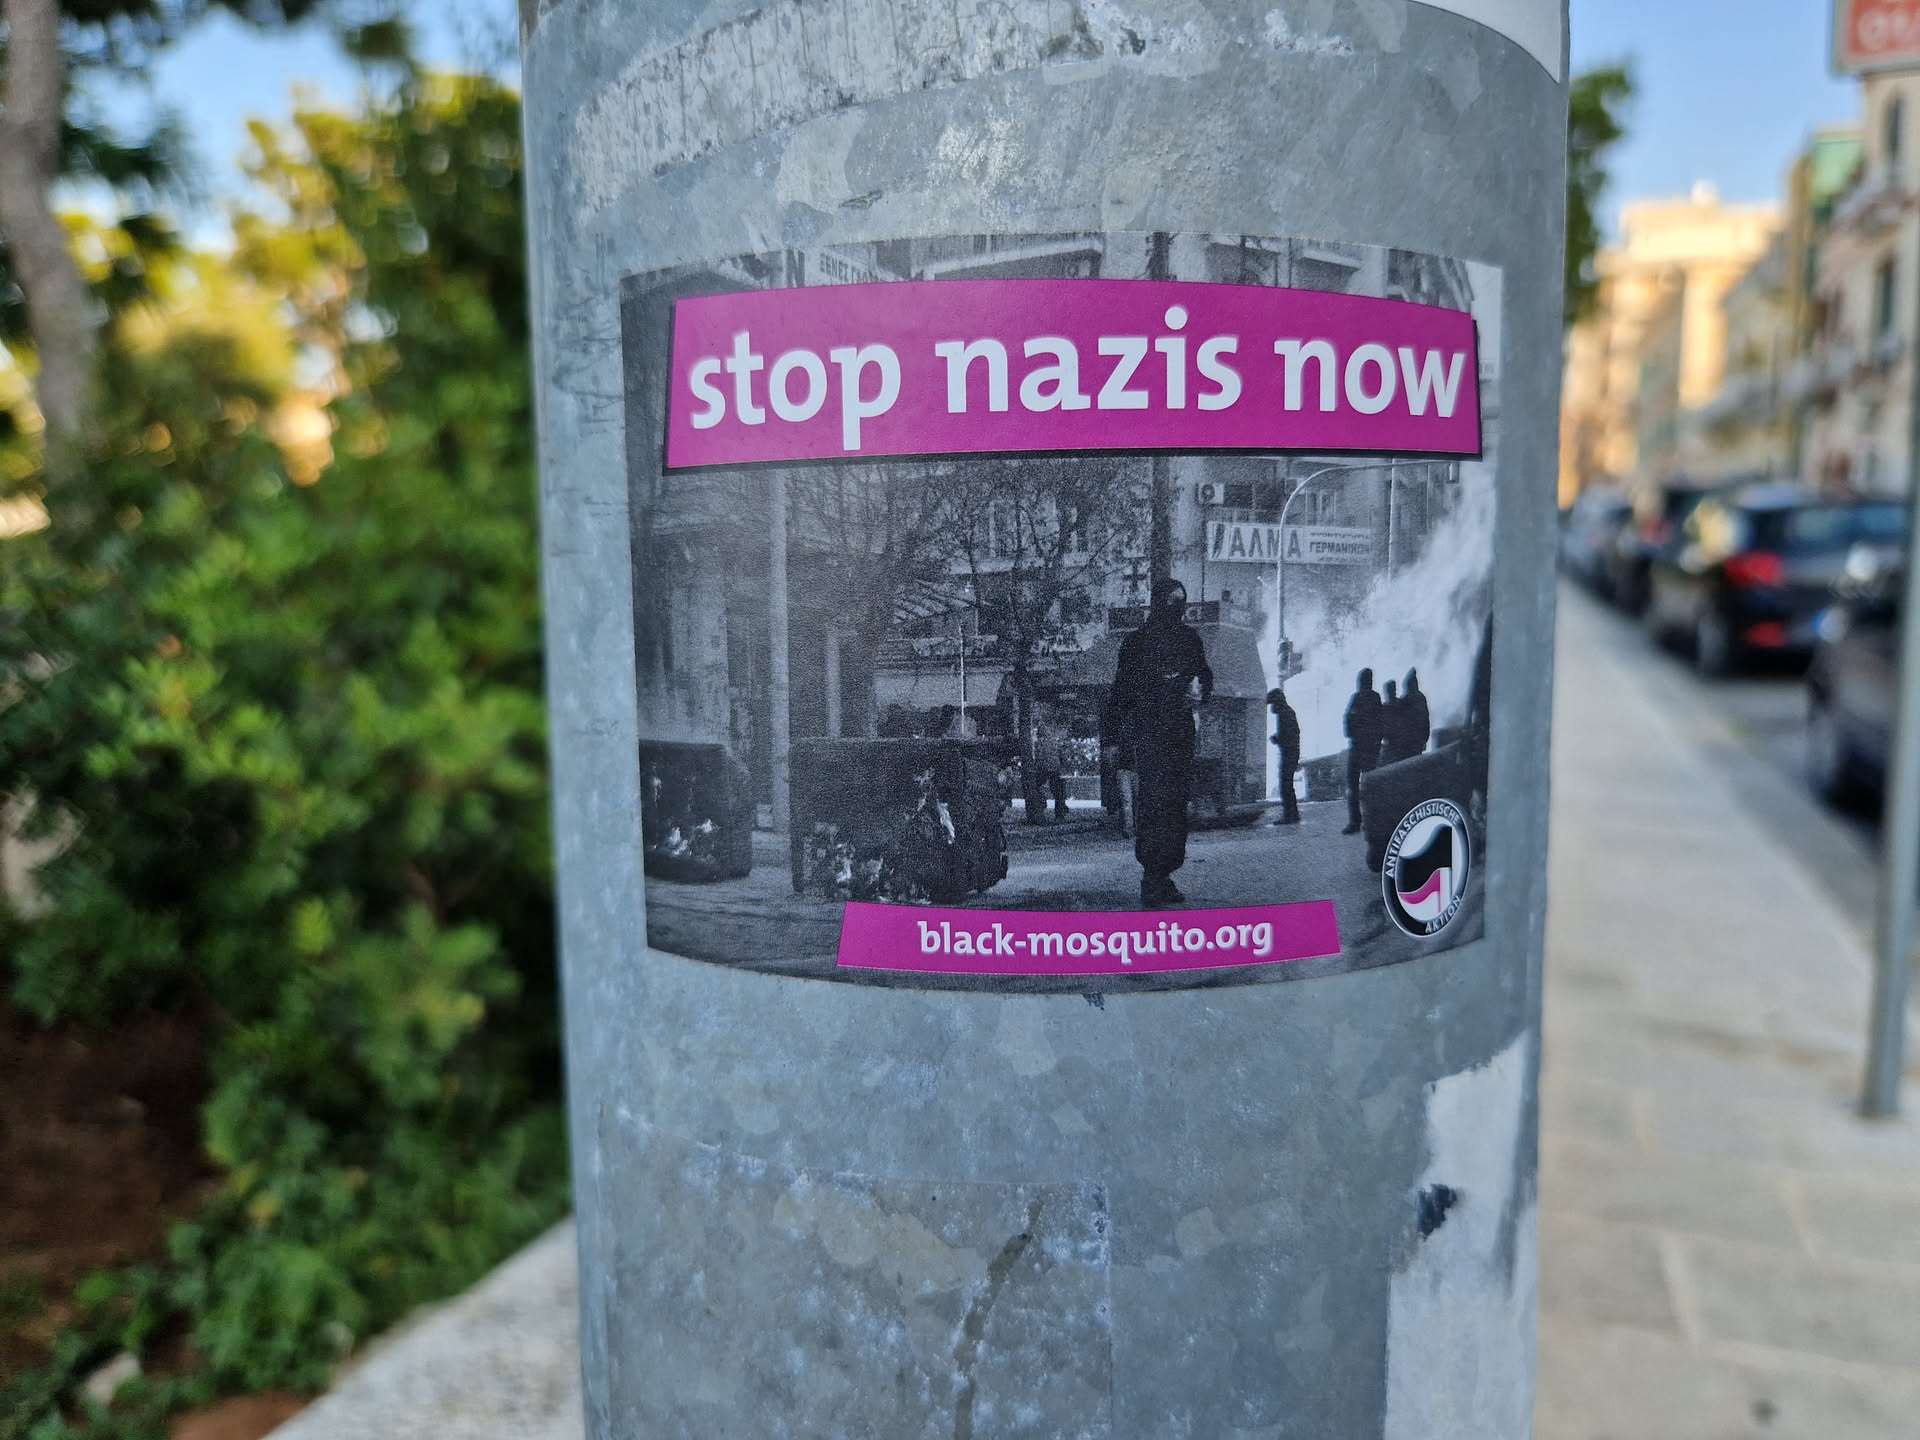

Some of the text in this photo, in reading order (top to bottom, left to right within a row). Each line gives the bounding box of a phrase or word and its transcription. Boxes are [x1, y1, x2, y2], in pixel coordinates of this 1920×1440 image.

[690, 306, 1467, 450] stop nazis now
[1385, 802, 1460, 880] ANTIFASCHISTISCHE
[917, 920, 1274, 964] black-mosquito.org
[1424, 895, 1461, 934] AKTION
